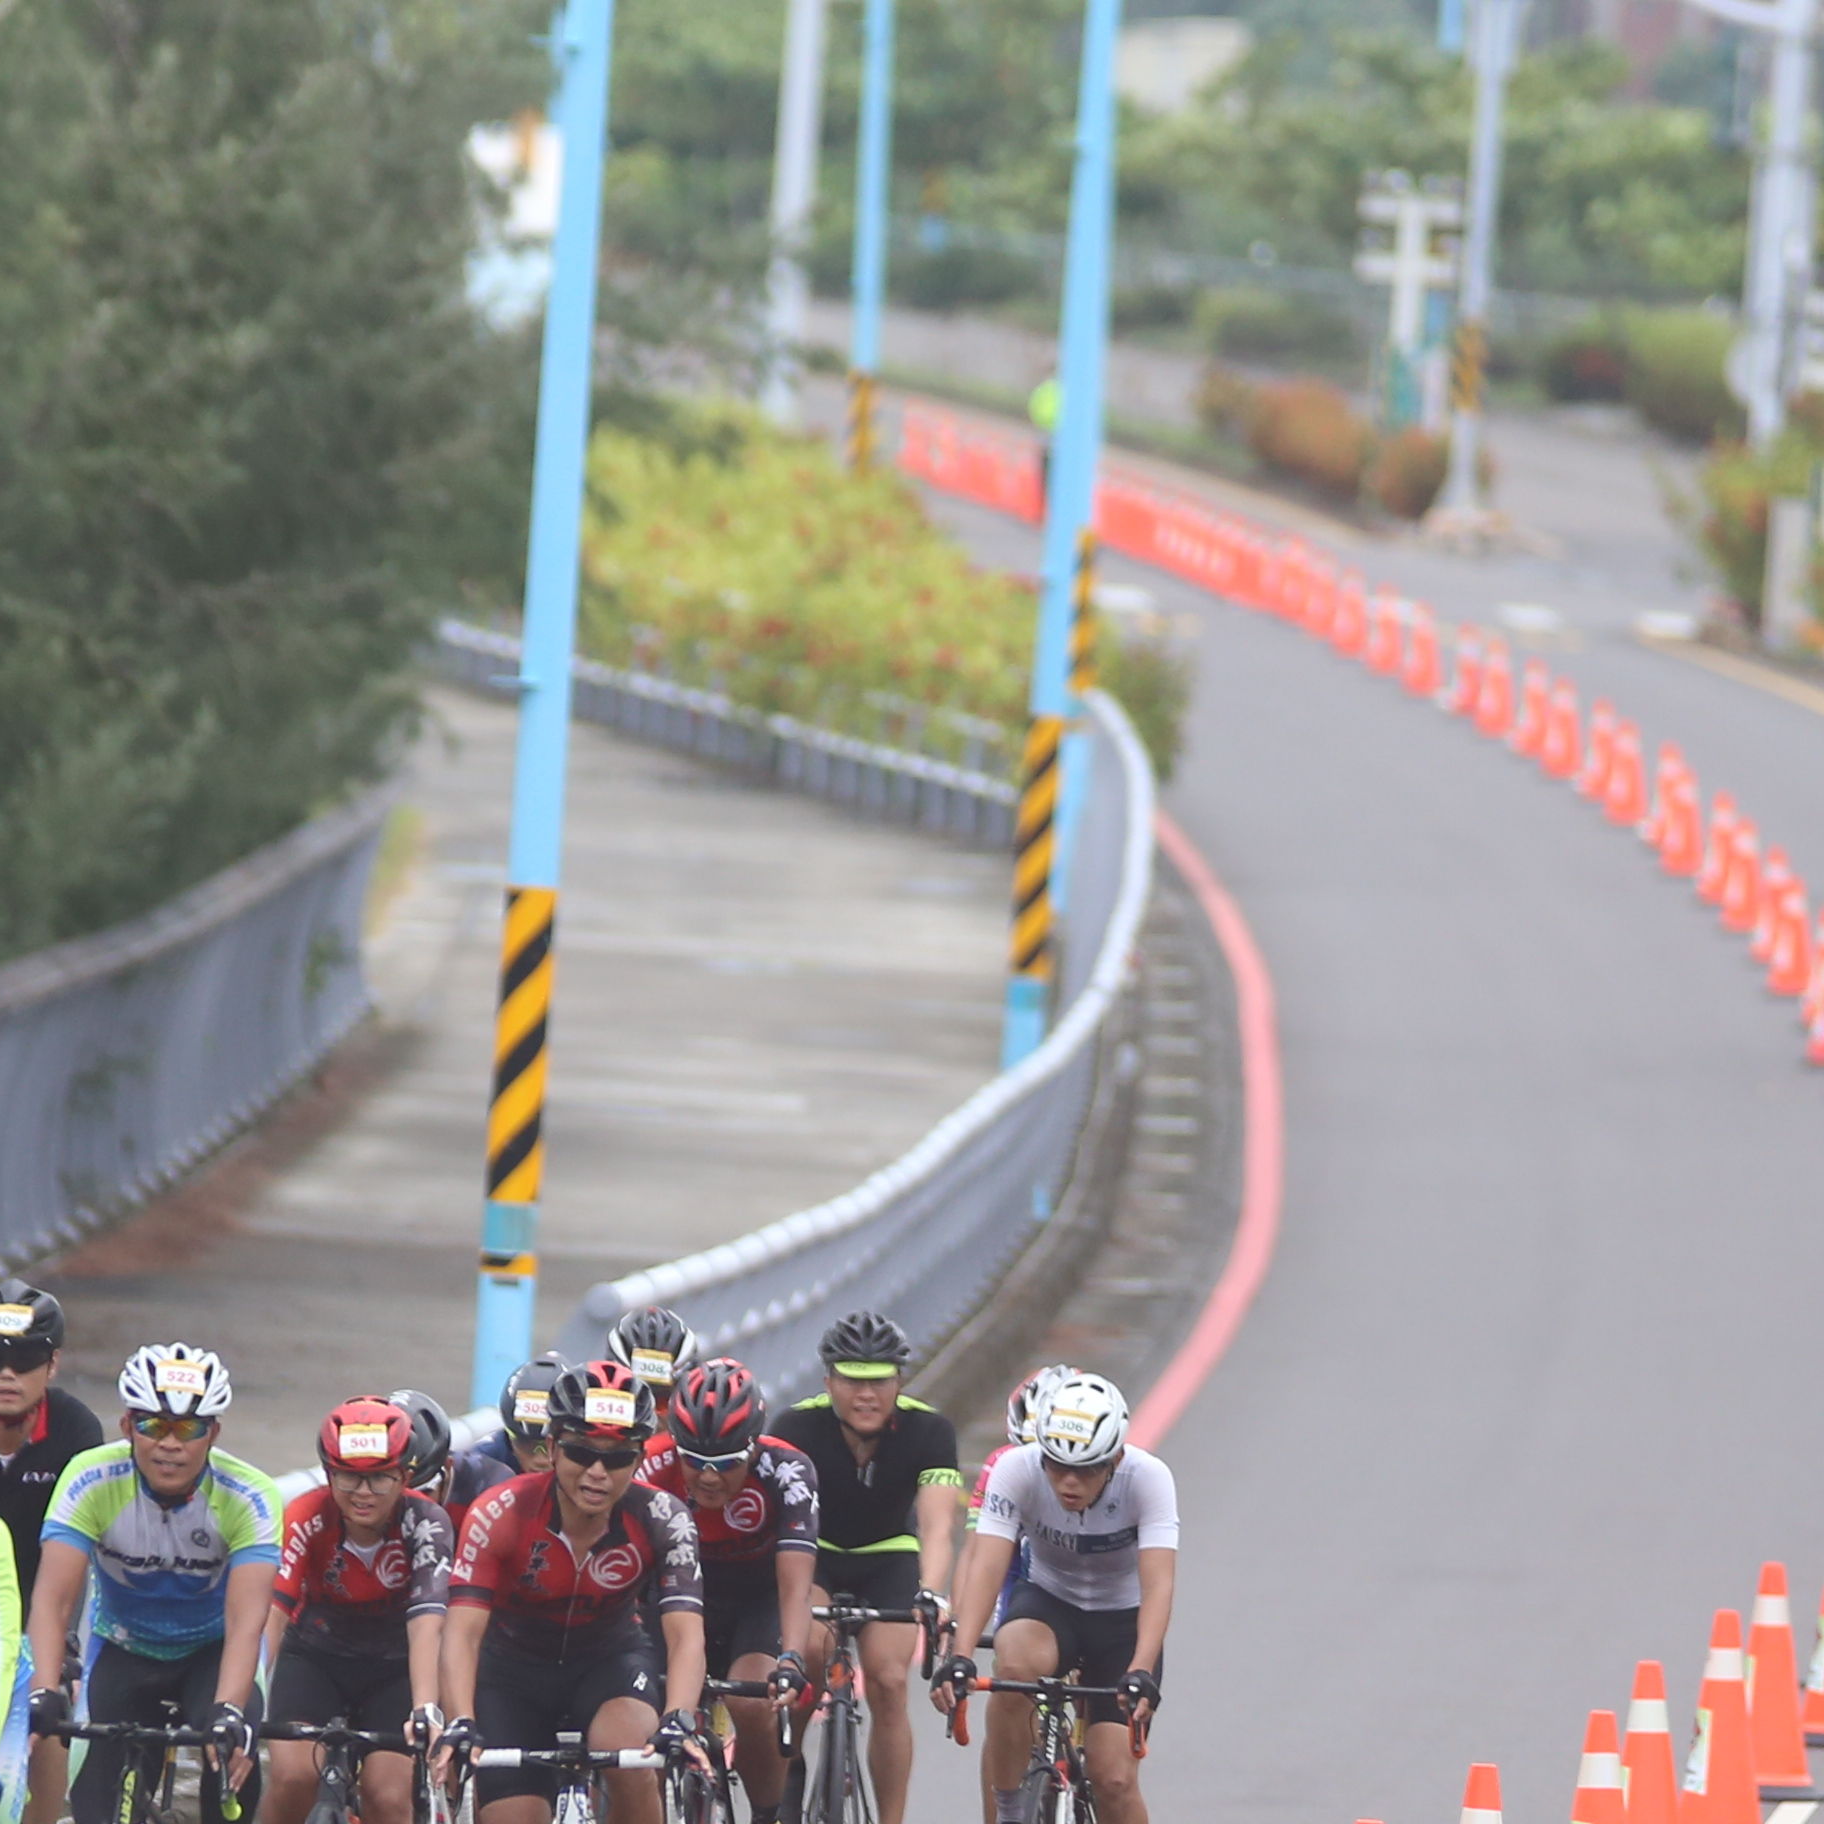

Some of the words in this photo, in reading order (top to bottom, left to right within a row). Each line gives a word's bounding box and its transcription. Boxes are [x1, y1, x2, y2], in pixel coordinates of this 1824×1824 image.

[167, 1371, 195, 1383] 522
[596, 1402, 625, 1415] 514
[1058, 1420, 1084, 1433] 306
[350, 1437, 376, 1448] 501
[452, 1488, 516, 1582] Eagles
